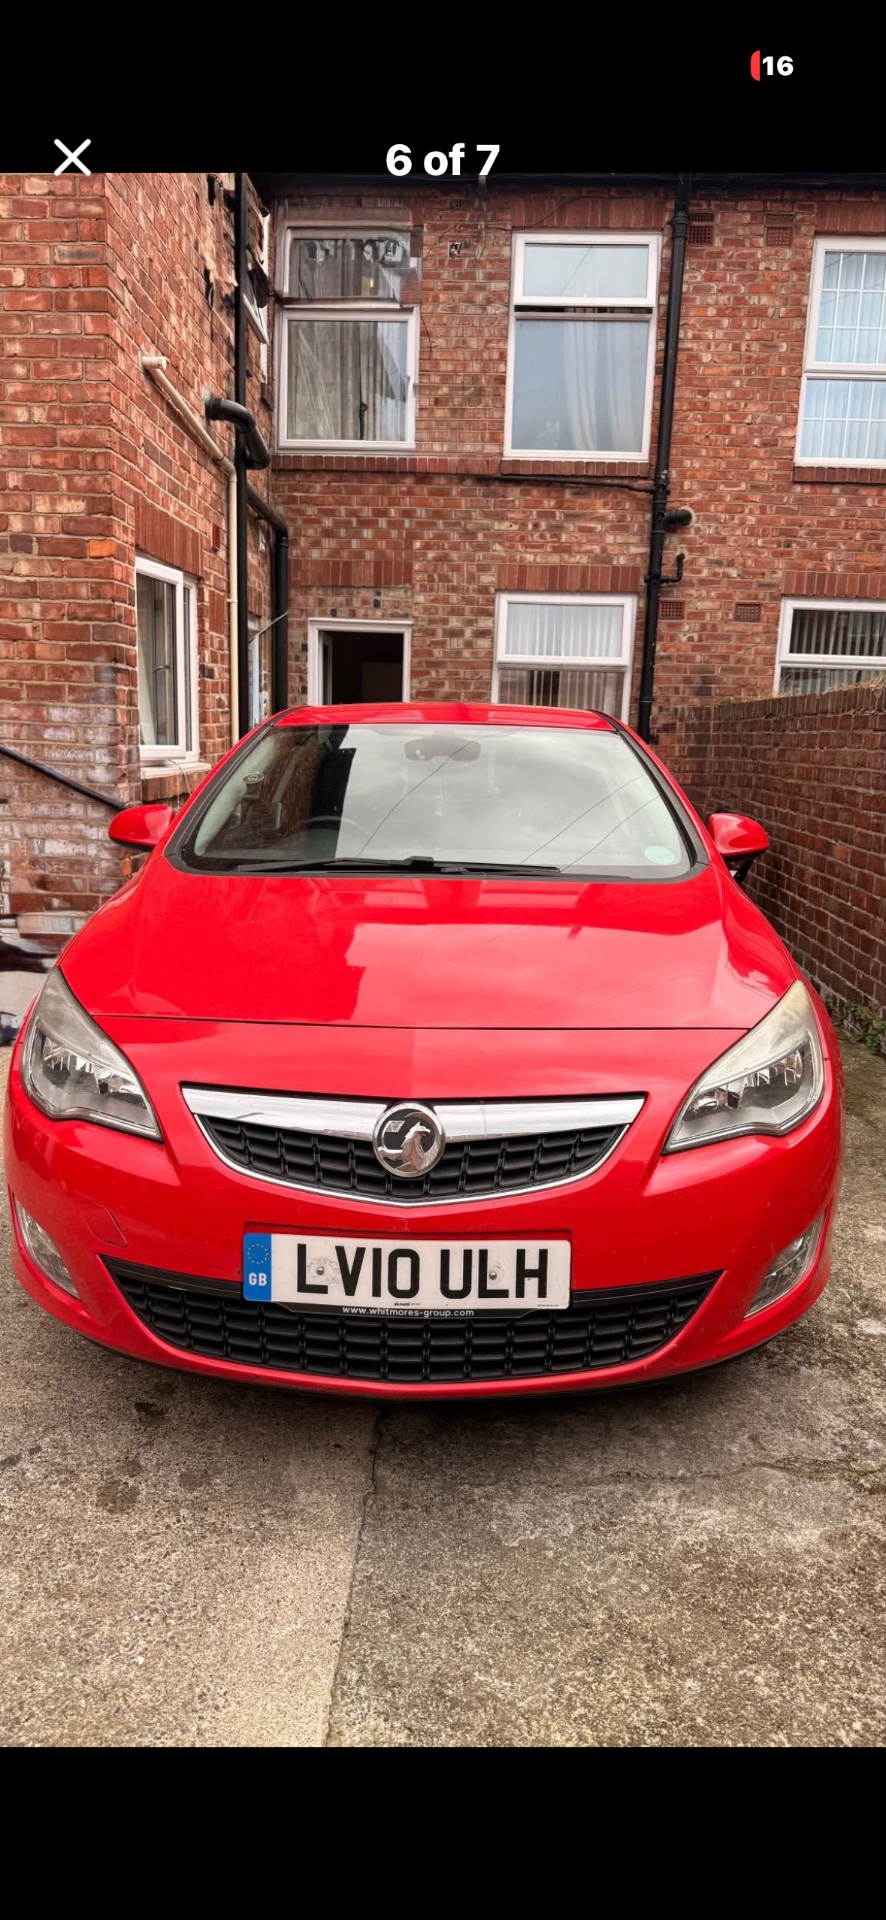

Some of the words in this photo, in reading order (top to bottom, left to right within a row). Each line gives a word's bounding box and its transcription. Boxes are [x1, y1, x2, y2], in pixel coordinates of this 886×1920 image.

[296, 1243, 420, 1300] LV10
[439, 1248, 549, 1300] ULH
[248, 1272, 268, 1287] GB
[342, 1305, 475, 1319] www.whitmores-group.com
